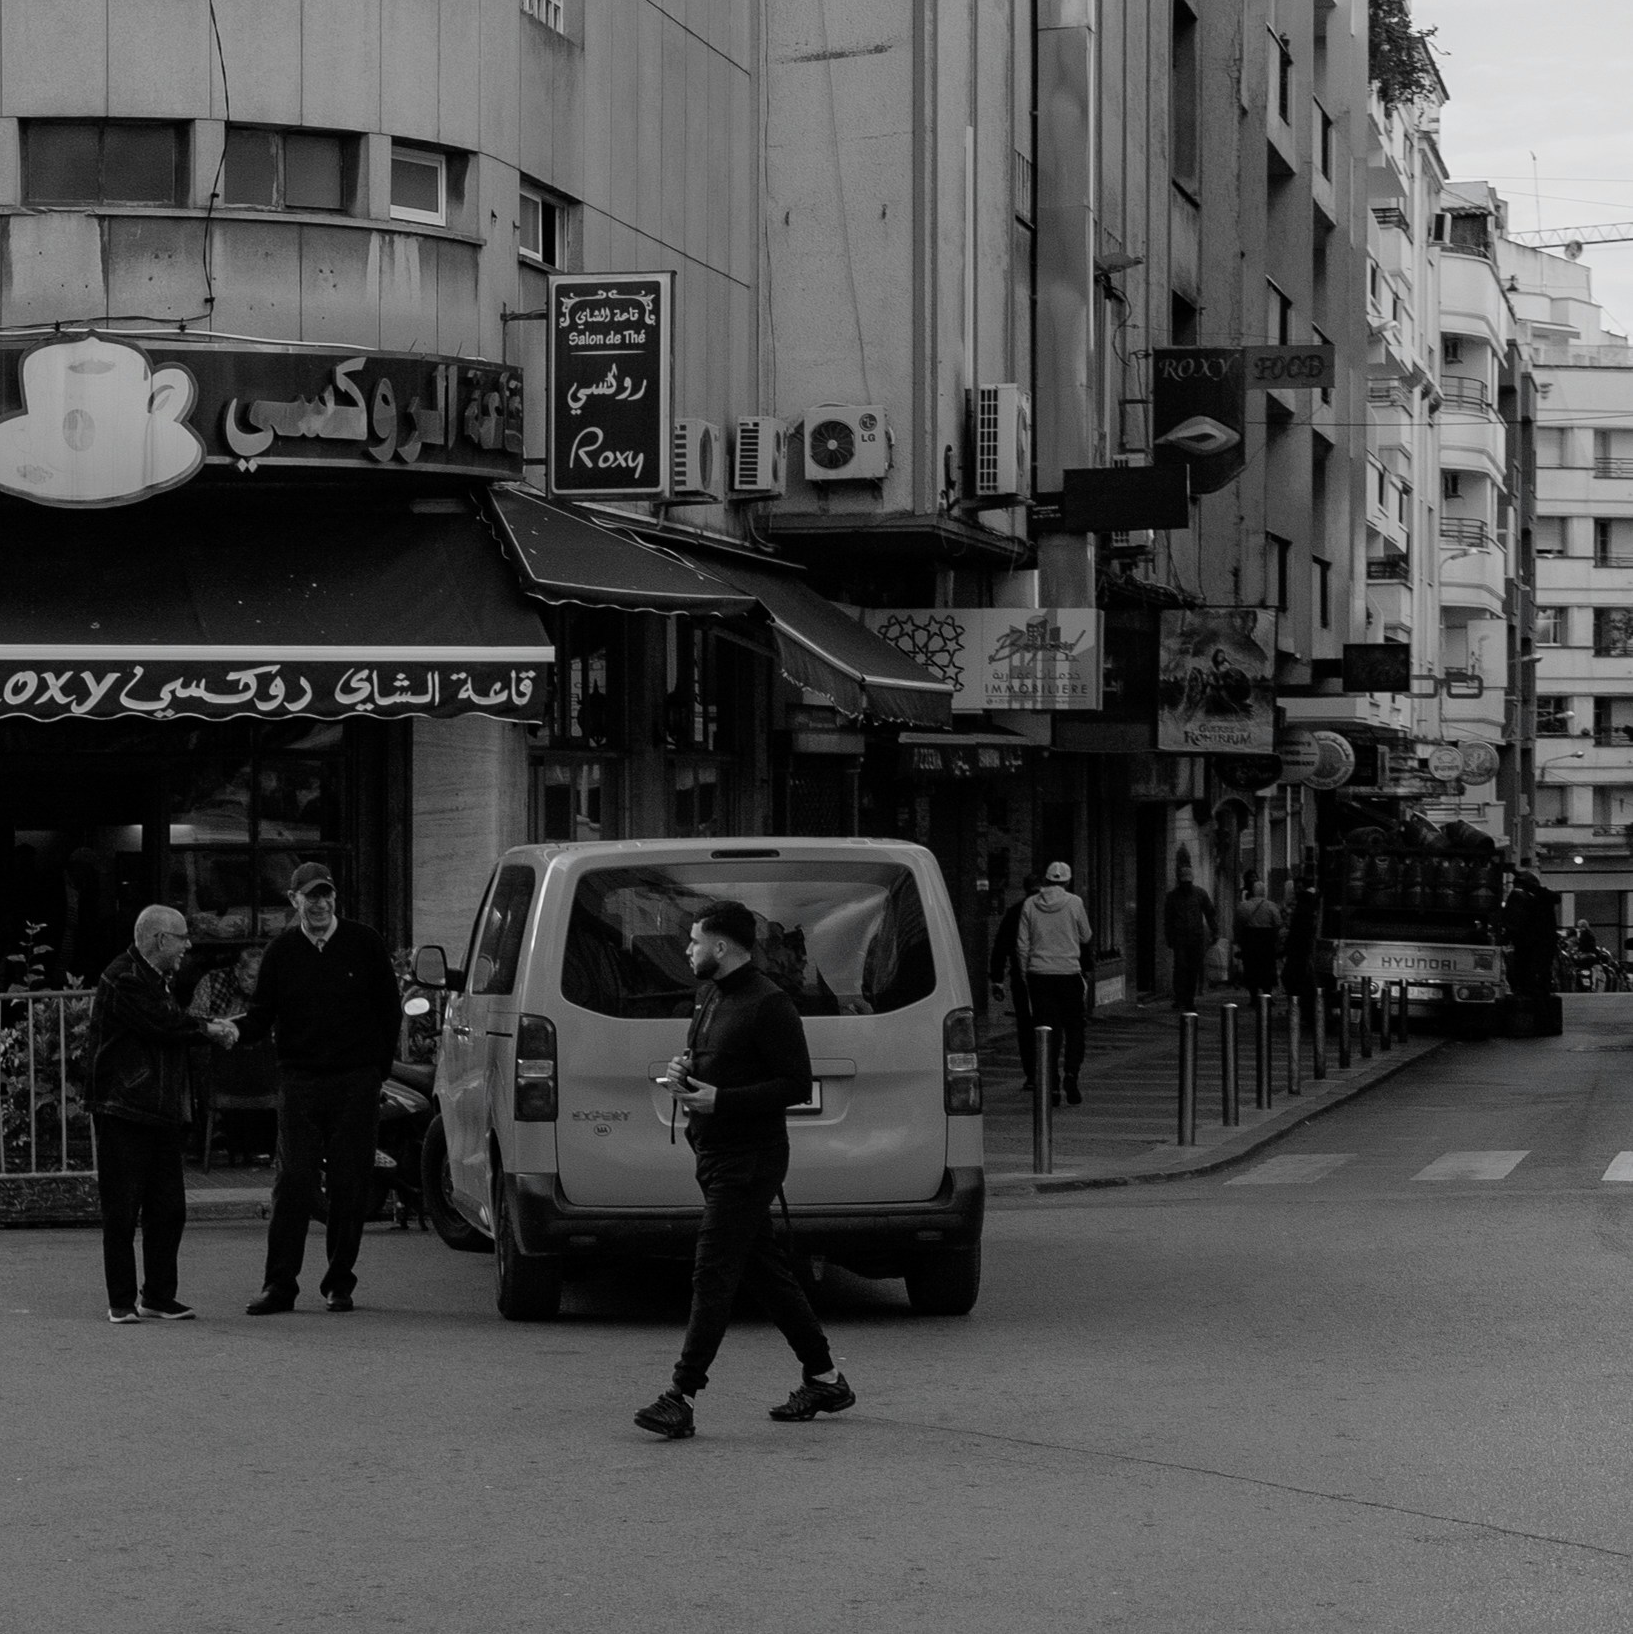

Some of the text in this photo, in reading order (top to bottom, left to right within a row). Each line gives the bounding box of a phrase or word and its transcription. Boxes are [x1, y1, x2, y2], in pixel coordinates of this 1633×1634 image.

[575, 306, 639, 329] قاعة الشاي
[568, 328, 646, 346] Salon de Thé
[1158, 353, 1325, 381] ROXY FOOD
[567, 362, 647, 416] روكسي
[861, 433, 876, 443] LG
[569, 426, 644, 480] Roxy
[118, 664, 537, 718] قاعة الشاي روكسي
[984, 683, 1088, 695] IMMOBILIERE
[1381, 956, 1458, 971] HYUNDAI
[572, 1110, 631, 1122] EXPERT
